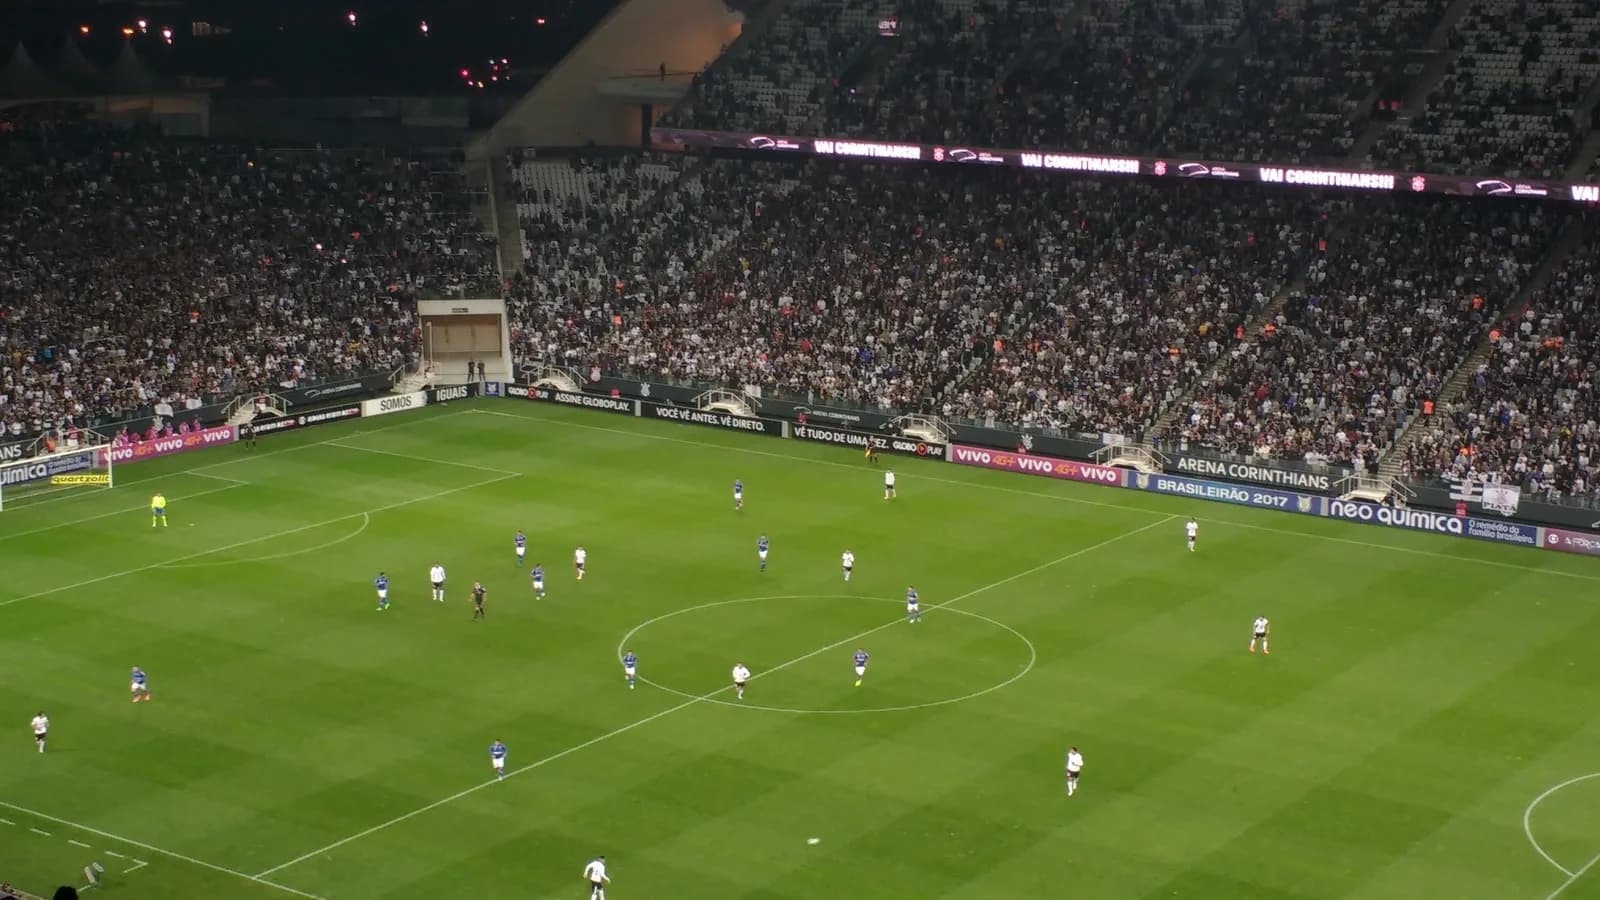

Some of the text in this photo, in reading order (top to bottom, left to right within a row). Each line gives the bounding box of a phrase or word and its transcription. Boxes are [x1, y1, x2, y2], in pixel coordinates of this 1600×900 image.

[815, 140, 834, 153] VAI
[1021, 153, 1042, 167] VAI
[1260, 167, 1283, 182] VAI
[1571, 186, 1599, 201] VAI
[436, 386, 468, 402] IGUAIS
[555, 391, 631, 411] ASSINE GLOBOPLAY.
[380, 395, 412, 412] SOMOS
[656, 406, 766, 431] VOCÊ VÊ ANTES. VÊ DIRETO.
[155, 440, 183, 453] VIVO
[203, 430, 230, 443] VIVO
[794, 425, 806, 438] VÊ
[807, 428, 833, 441] TUDO
[833, 432, 846, 443] DE
[846, 434, 868, 446] UMA
[957, 449, 1116, 482] VIVO 4G+ VIVO 4G+ VIVO
[1177, 457, 1329, 490] ARENA CORINTHIANS
[53, 474, 110, 483] quartzolit
[1157, 478, 1289, 508] BRASILEIRÃO 2017
[1330, 501, 1373, 520] neo
[1468, 519, 1475, 527] O
[1509, 526, 1520, 534] da
